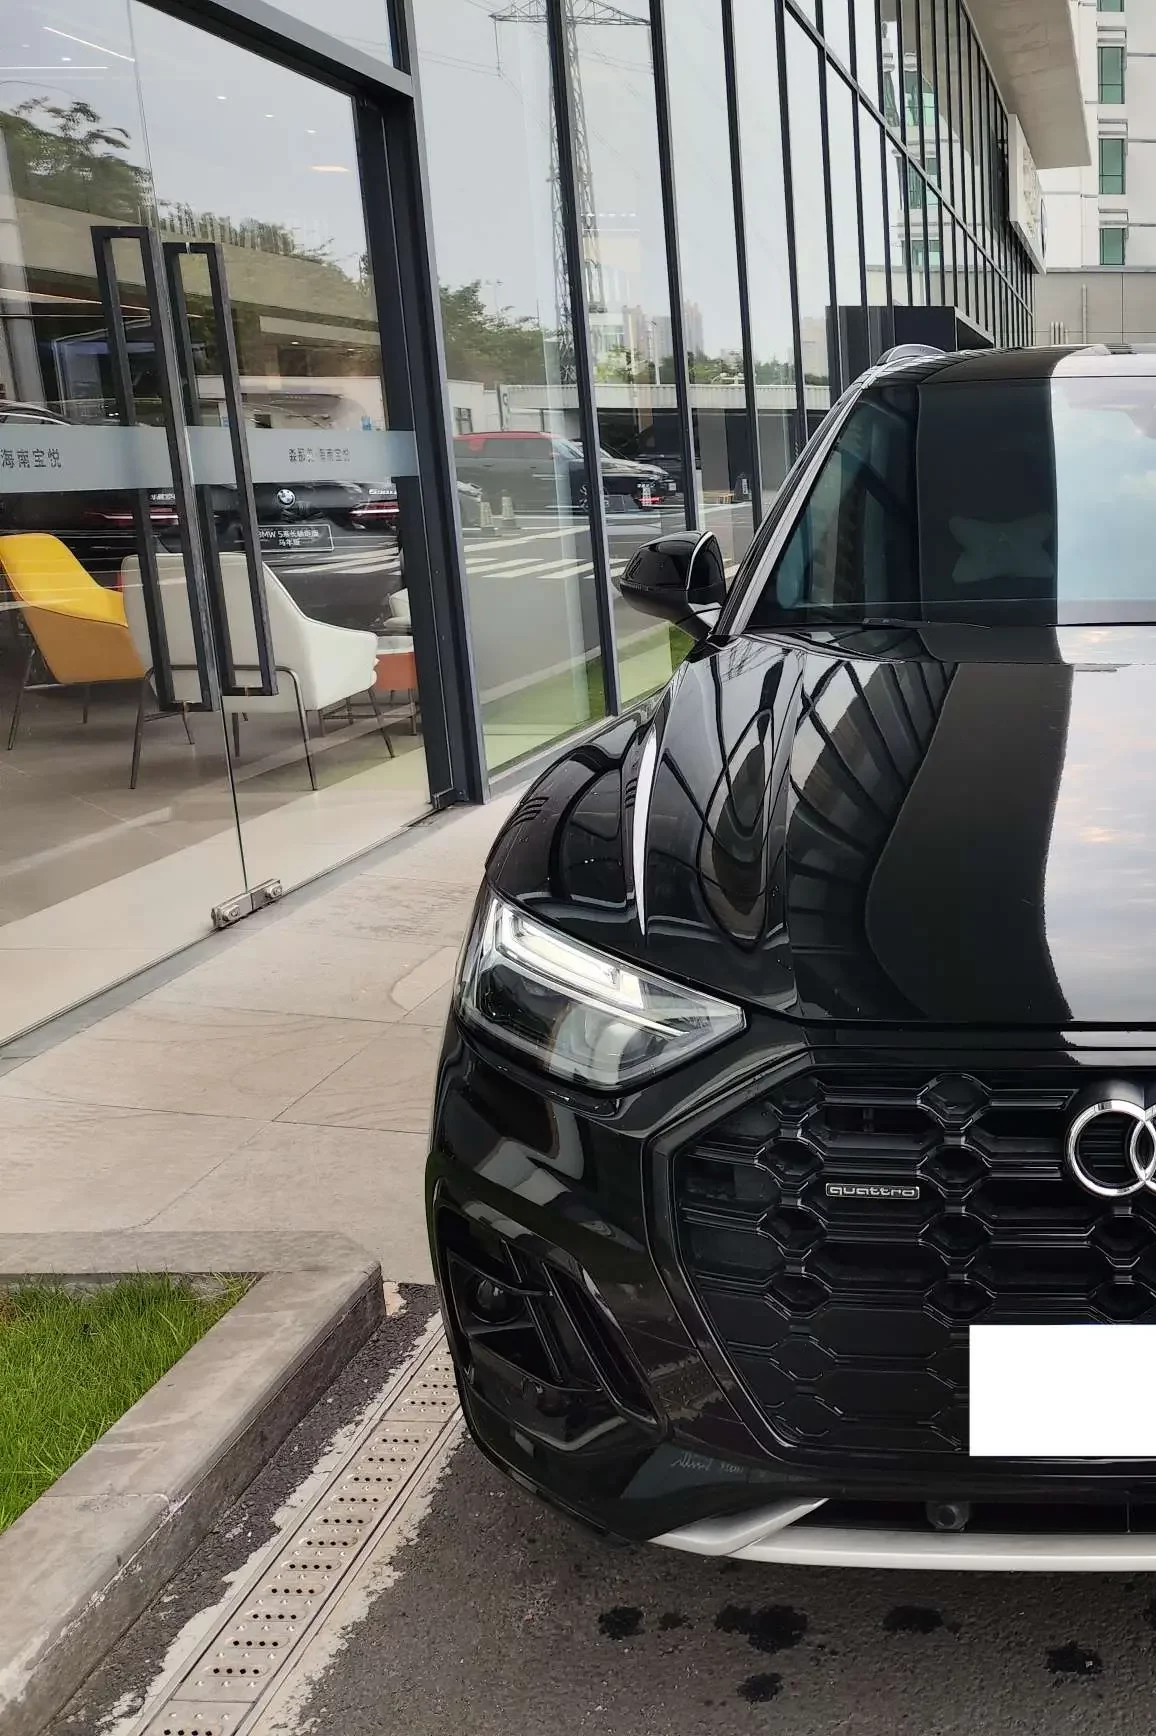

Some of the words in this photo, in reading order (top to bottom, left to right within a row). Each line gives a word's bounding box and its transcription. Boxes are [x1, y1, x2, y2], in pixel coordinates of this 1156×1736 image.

[1, 449, 62, 468] 海南宝悦
[830, 1187, 915, 1196] quattro
